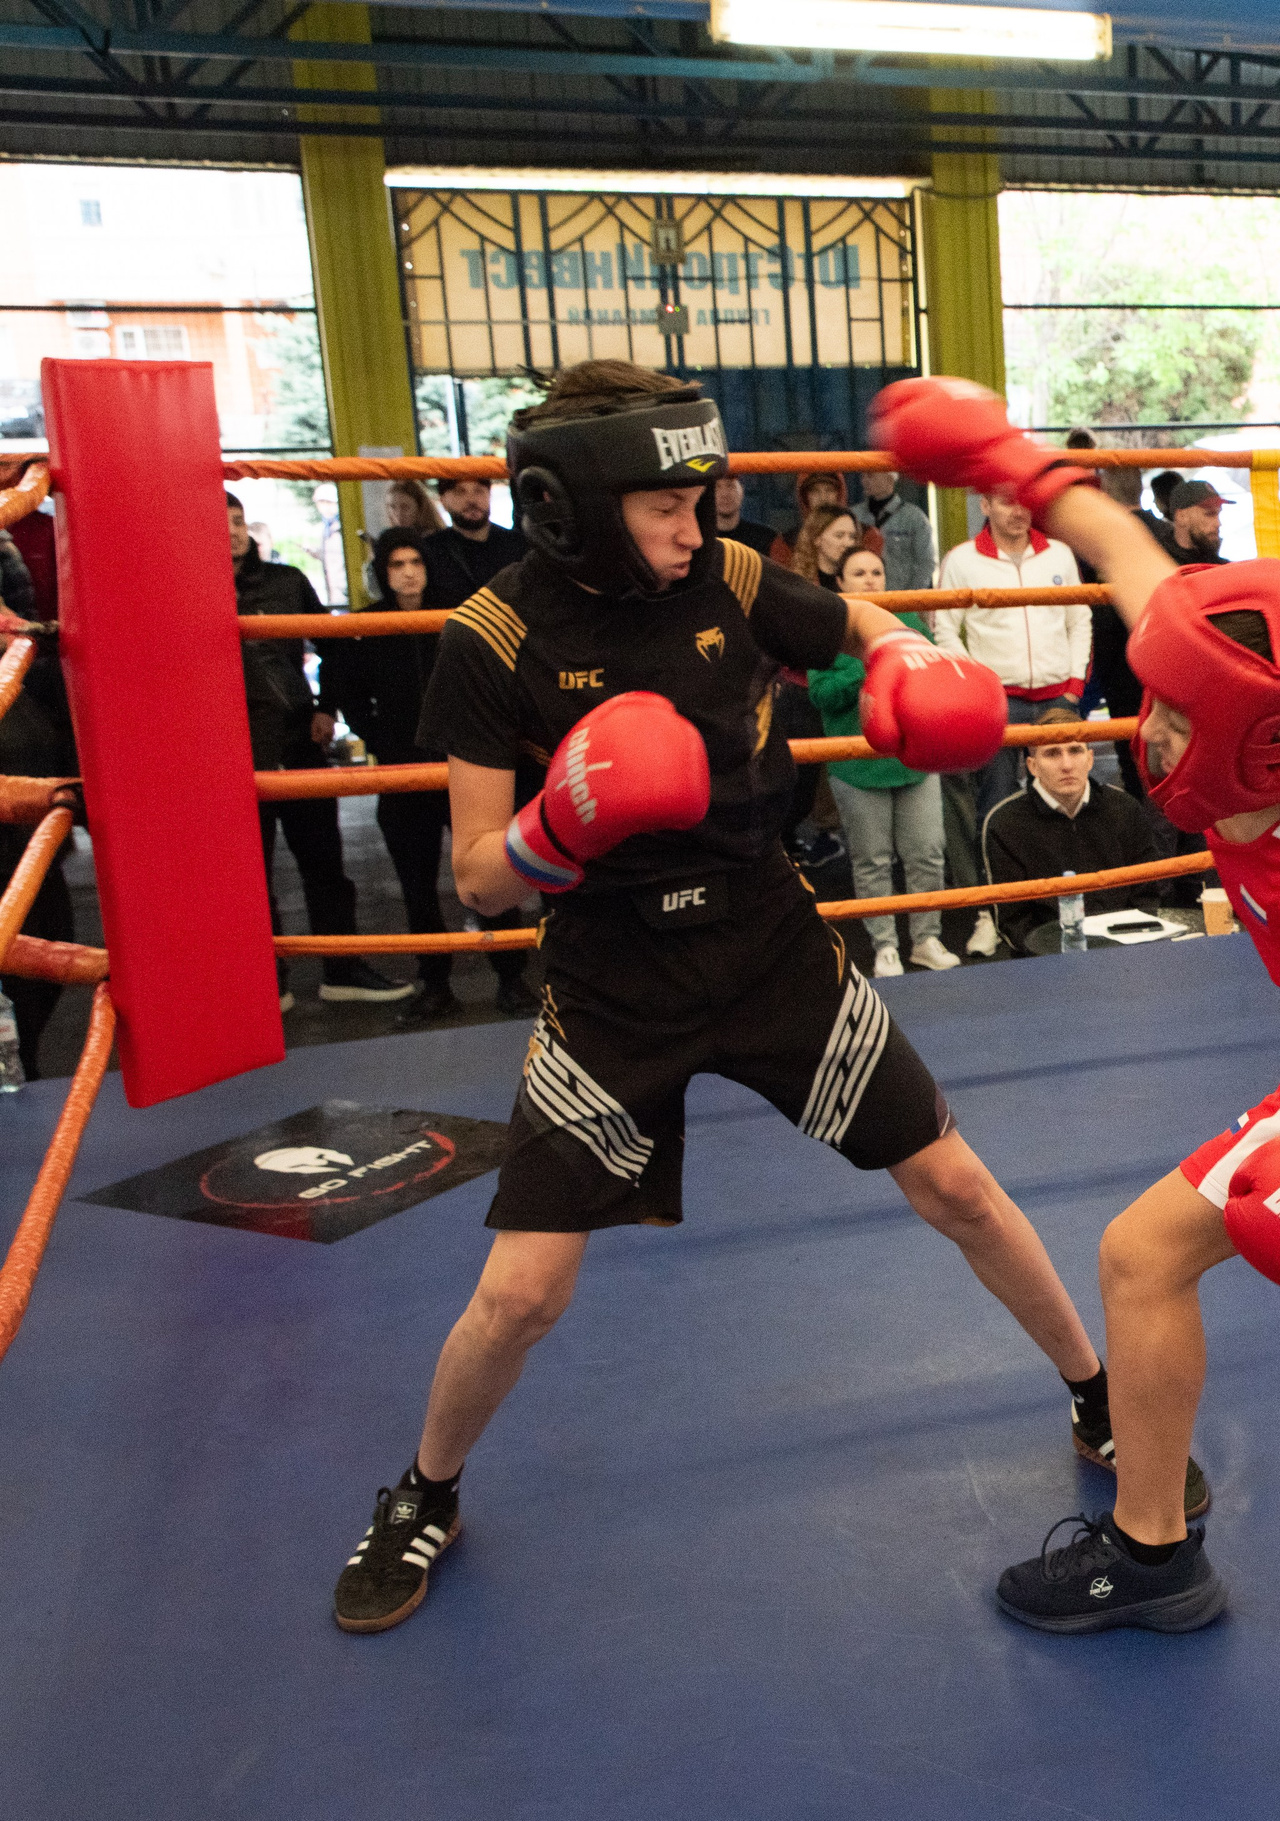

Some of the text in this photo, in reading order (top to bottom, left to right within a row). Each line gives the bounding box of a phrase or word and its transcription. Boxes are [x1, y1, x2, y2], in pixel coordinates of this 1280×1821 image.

[558, 668, 605, 690] UFC
[663, 887, 706, 912] UFC
[298, 1140, 432, 1199] GO FIGHT
